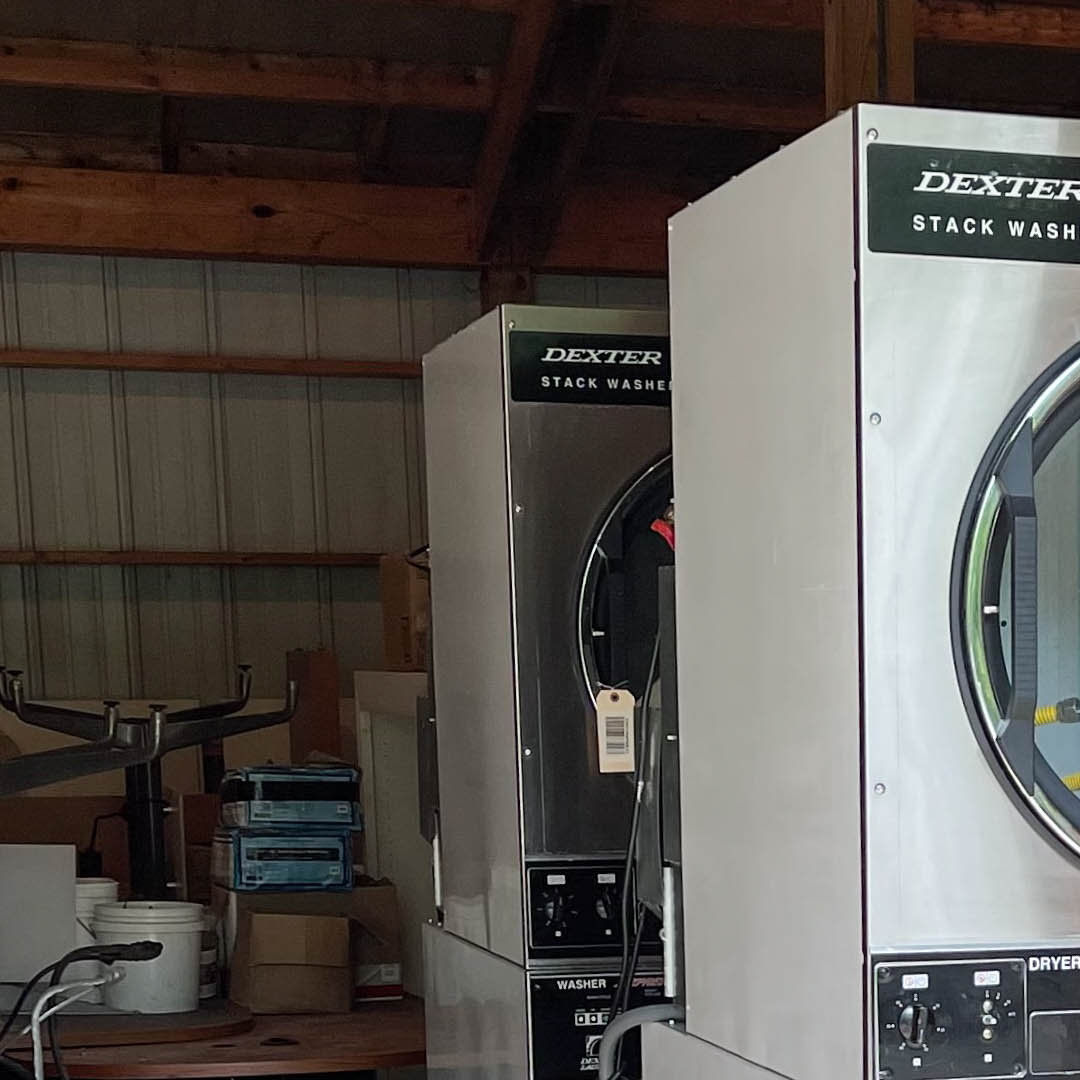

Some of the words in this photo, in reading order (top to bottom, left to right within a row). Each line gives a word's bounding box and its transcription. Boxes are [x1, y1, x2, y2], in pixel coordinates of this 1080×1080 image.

[912, 214, 994, 236] STACK
[541, 347, 662, 365] DEXTER
[541, 376, 598, 389] STACK
[557, 978, 607, 990] WASHER
